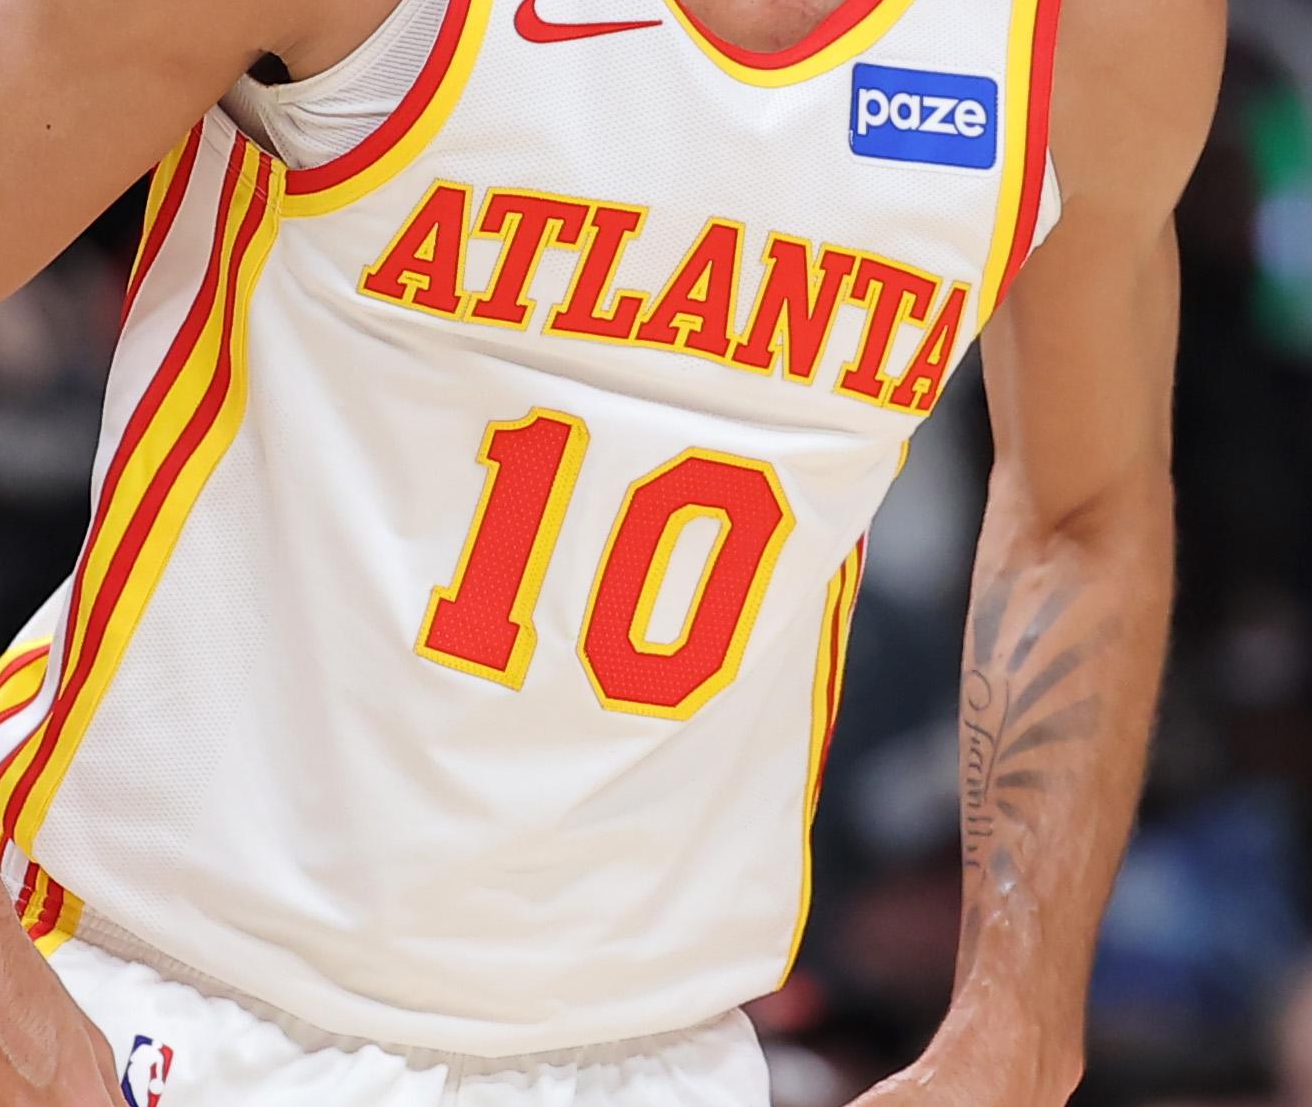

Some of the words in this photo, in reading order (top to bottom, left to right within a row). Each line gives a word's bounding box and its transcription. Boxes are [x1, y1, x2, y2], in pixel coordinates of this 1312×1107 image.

[857, 87, 988, 138] paze
[357, 178, 973, 416] ATLANTA
[414, 406, 796, 721] 10
